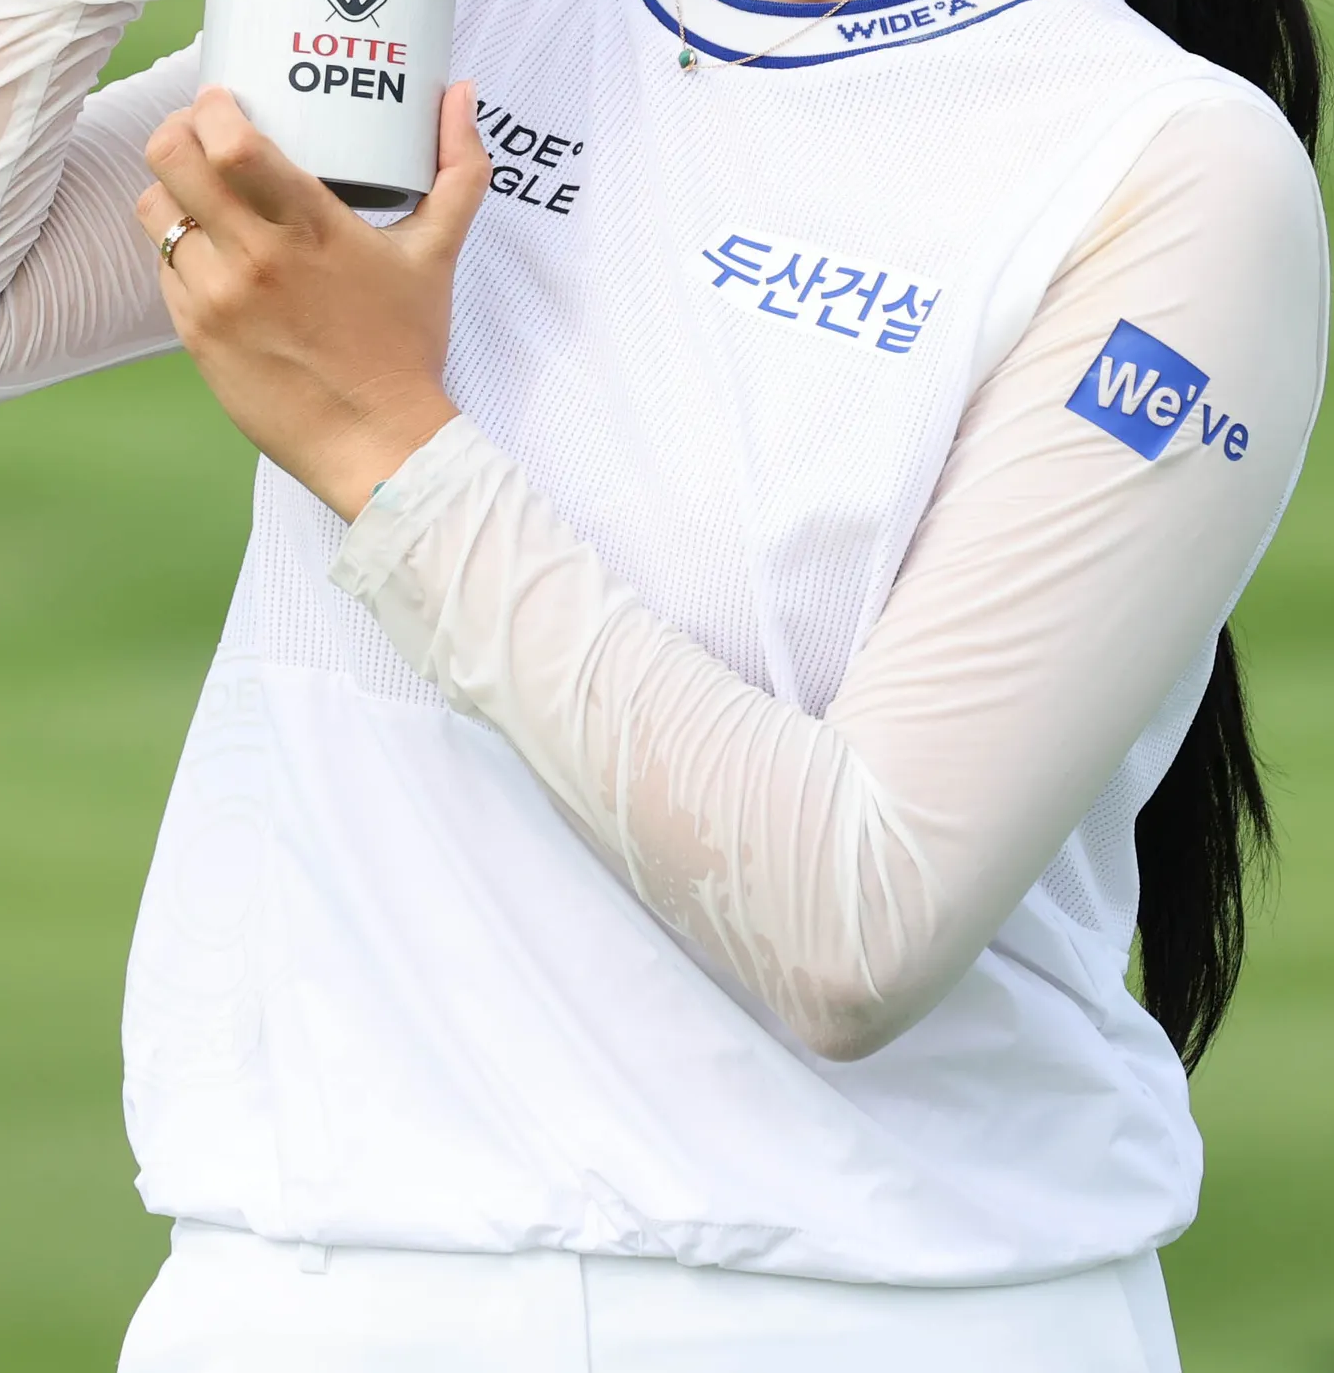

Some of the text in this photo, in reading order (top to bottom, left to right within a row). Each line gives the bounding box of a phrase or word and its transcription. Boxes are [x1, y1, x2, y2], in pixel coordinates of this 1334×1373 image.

[292, 31, 408, 65] LOTTE
[288, 61, 406, 104] OPEN
[488, 152, 581, 215] GLE
[702, 234, 943, 354] 두산건설
[1097, 355, 1250, 462] We've
